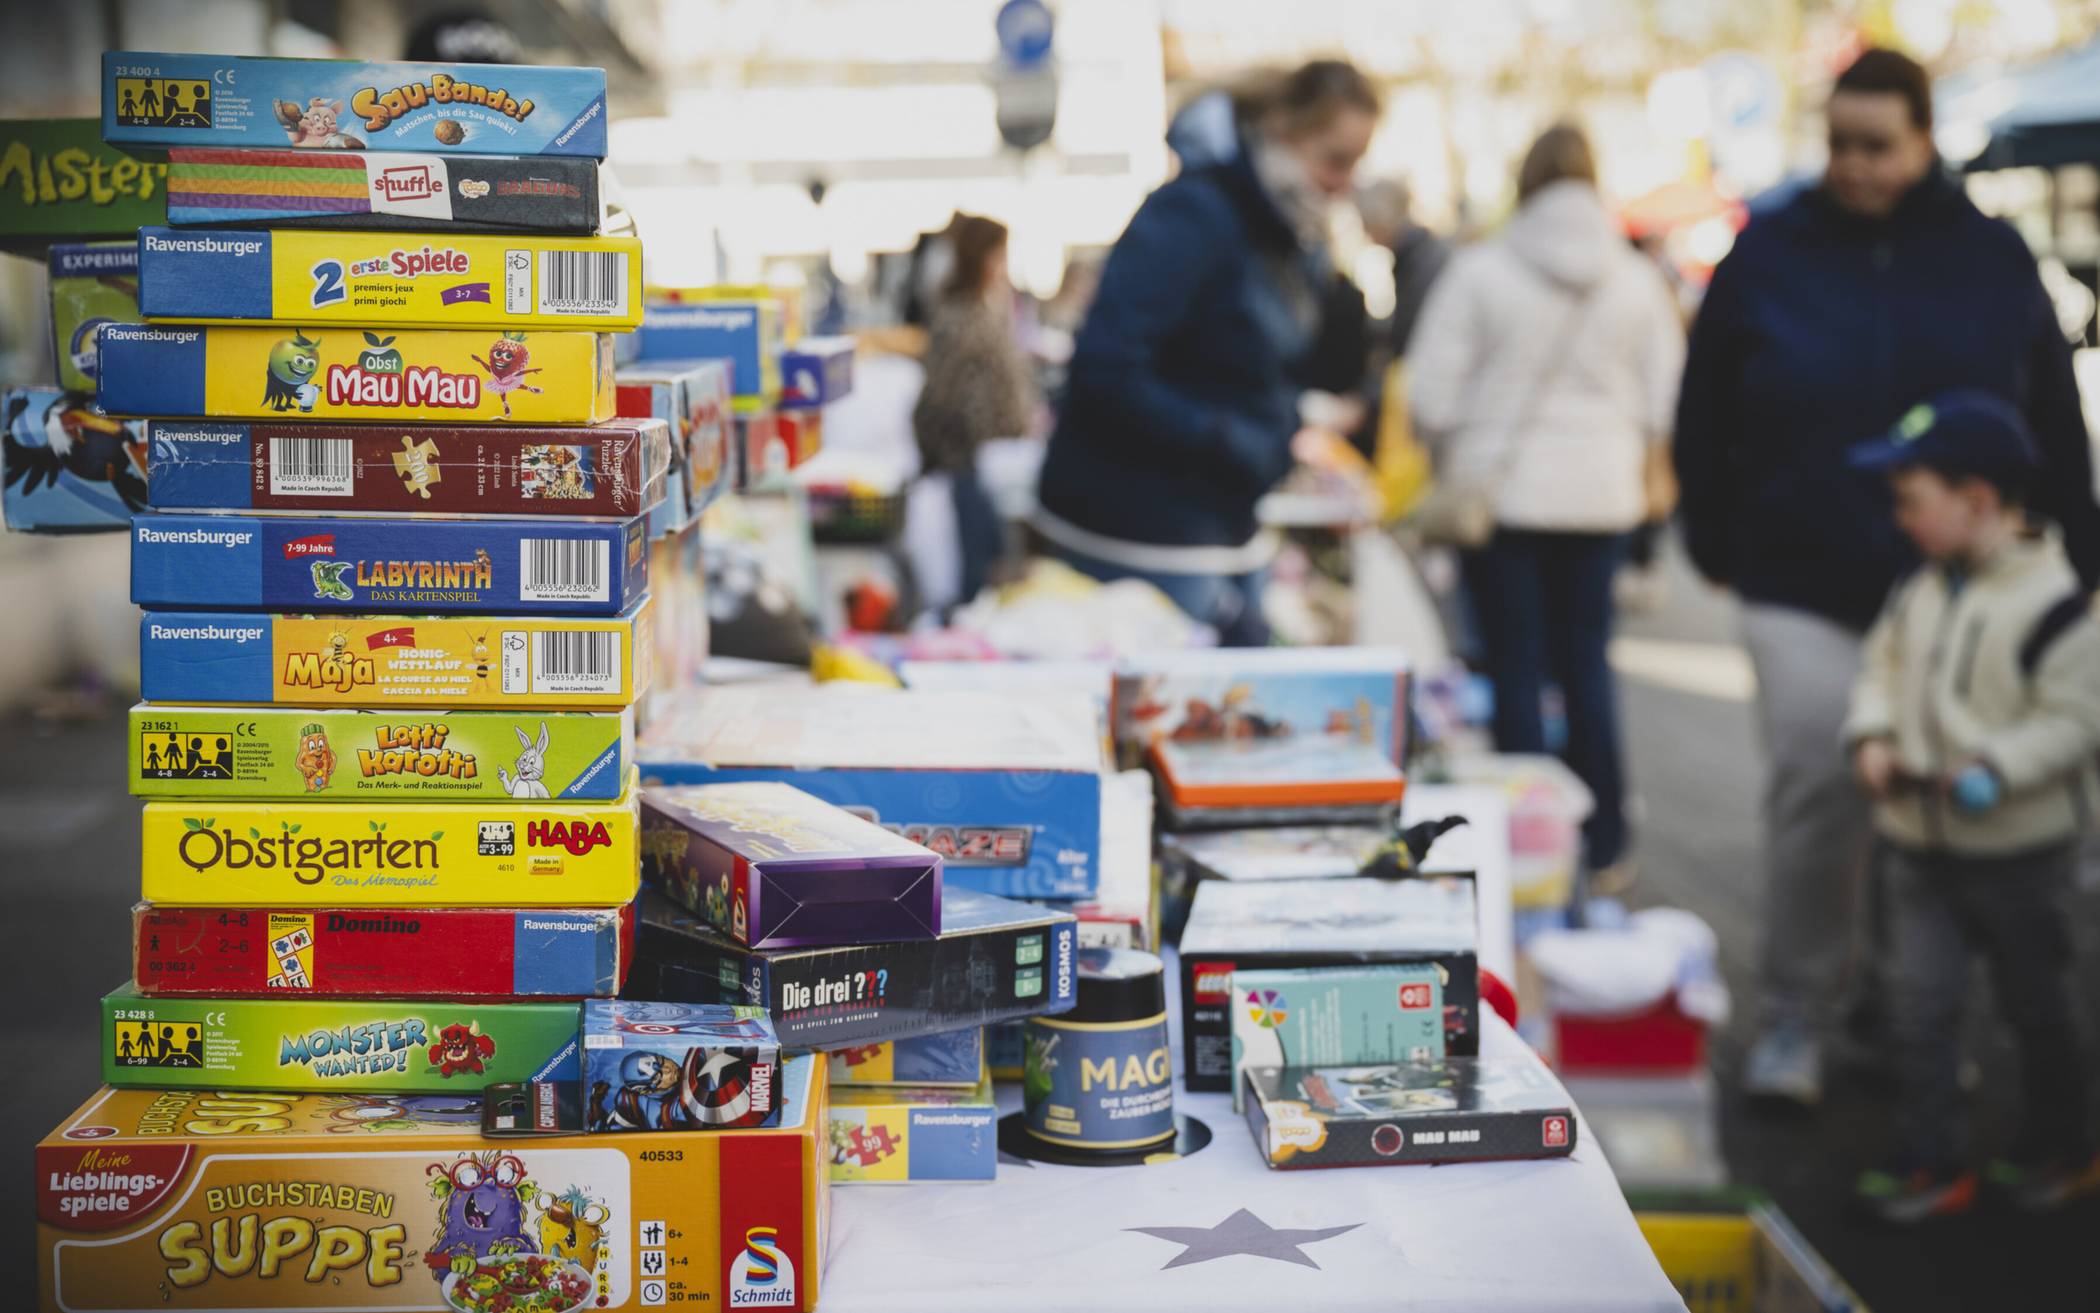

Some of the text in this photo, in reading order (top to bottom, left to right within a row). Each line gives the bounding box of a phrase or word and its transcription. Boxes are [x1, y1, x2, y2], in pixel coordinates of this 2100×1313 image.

[115, 66, 127, 76] 23
[130, 67, 151, 77] 400
[351, 73, 535, 133] Sau-Bande!
[437, 109, 451, 118] bis
[452, 108, 467, 117] die
[468, 110, 485, 120] Sau
[555, 101, 601, 147] Ravensburger
[374, 167, 442, 198] shuffle
[145, 236, 262, 257] Ravensburger
[62, 254, 139, 270] EXPERIM
[313, 247, 468, 306] 2 erste Spiele
[353, 283, 414, 294] premiers jeux
[455, 290, 471, 299] 3-7
[353, 296, 407, 308] primi giochi
[107, 328, 199, 344] Ravensburger
[365, 355, 398, 371] Obst
[331, 367, 477, 406] Mau Mau
[155, 430, 242, 445] Ravensburger
[602, 440, 611, 468] Puzzle
[405, 451, 430, 484] 200
[138, 528, 253, 548] Ravensburger
[287, 543, 333, 553] 7-99 Jahre
[357, 557, 492, 589] LABYRINTH
[371, 590, 480, 602] DAS KARTENSPIEL
[567, 584, 598, 592] 232062
[151, 624, 263, 643] Ravensburger
[383, 633, 398, 643] 4+
[283, 652, 375, 693] Maja
[388, 660, 462, 670] WETTLAUF
[378, 675, 472, 683] LA COURSE AU MIEL
[383, 687, 468, 695] CACCIA AL MIELE
[141, 722, 153, 731] 23
[155, 722, 172, 731] 162
[375, 723, 449, 750] Lotti
[356, 748, 478, 779] Karotti
[570, 749, 616, 794] Ravensburger
[357, 781, 483, 791] Das Merk- und Reaktionsspiel
[527, 819, 612, 856] HABA
[178, 822, 439, 885] Obstgarten
[498, 863, 515, 872] 4610
[532, 865, 561, 873] Germany
[331, 875, 359, 887] Das
[270, 915, 306, 923] Domino
[326, 913, 421, 934] Domino
[524, 919, 599, 932] Ravensburger
[1058, 930, 1071, 998] KOSMOS
[783, 969, 888, 1011] Die drei ???
[114, 1010, 155, 1019] 23 428 8
[279, 1018, 428, 1067] MONSTER
[313, 1050, 408, 1078] WANTED!
[532, 1040, 577, 1084] Ravensburger
[751, 1064, 771, 1112] MARVEL
[913, 1113, 992, 1127] Ravensburger
[862, 1136, 882, 1152] 99
[1412, 1129, 1480, 1145] MAU MAU
[76, 1149, 133, 1173] Meine
[639, 1150, 684, 1162] 40533
[49, 1172, 165, 1196] Lieblings-
[60, 1192, 130, 1217] spiele
[206, 1182, 394, 1219] BUCHSTABEN
[668, 1229, 683, 1240] 6+
[158, 1213, 406, 1290] SUPPE
[669, 1256, 689, 1266] 1-4
[669, 1281, 687, 1290] ca.
[669, 1291, 710, 1302] 30 min
[732, 1287, 793, 1304] Schmidt
